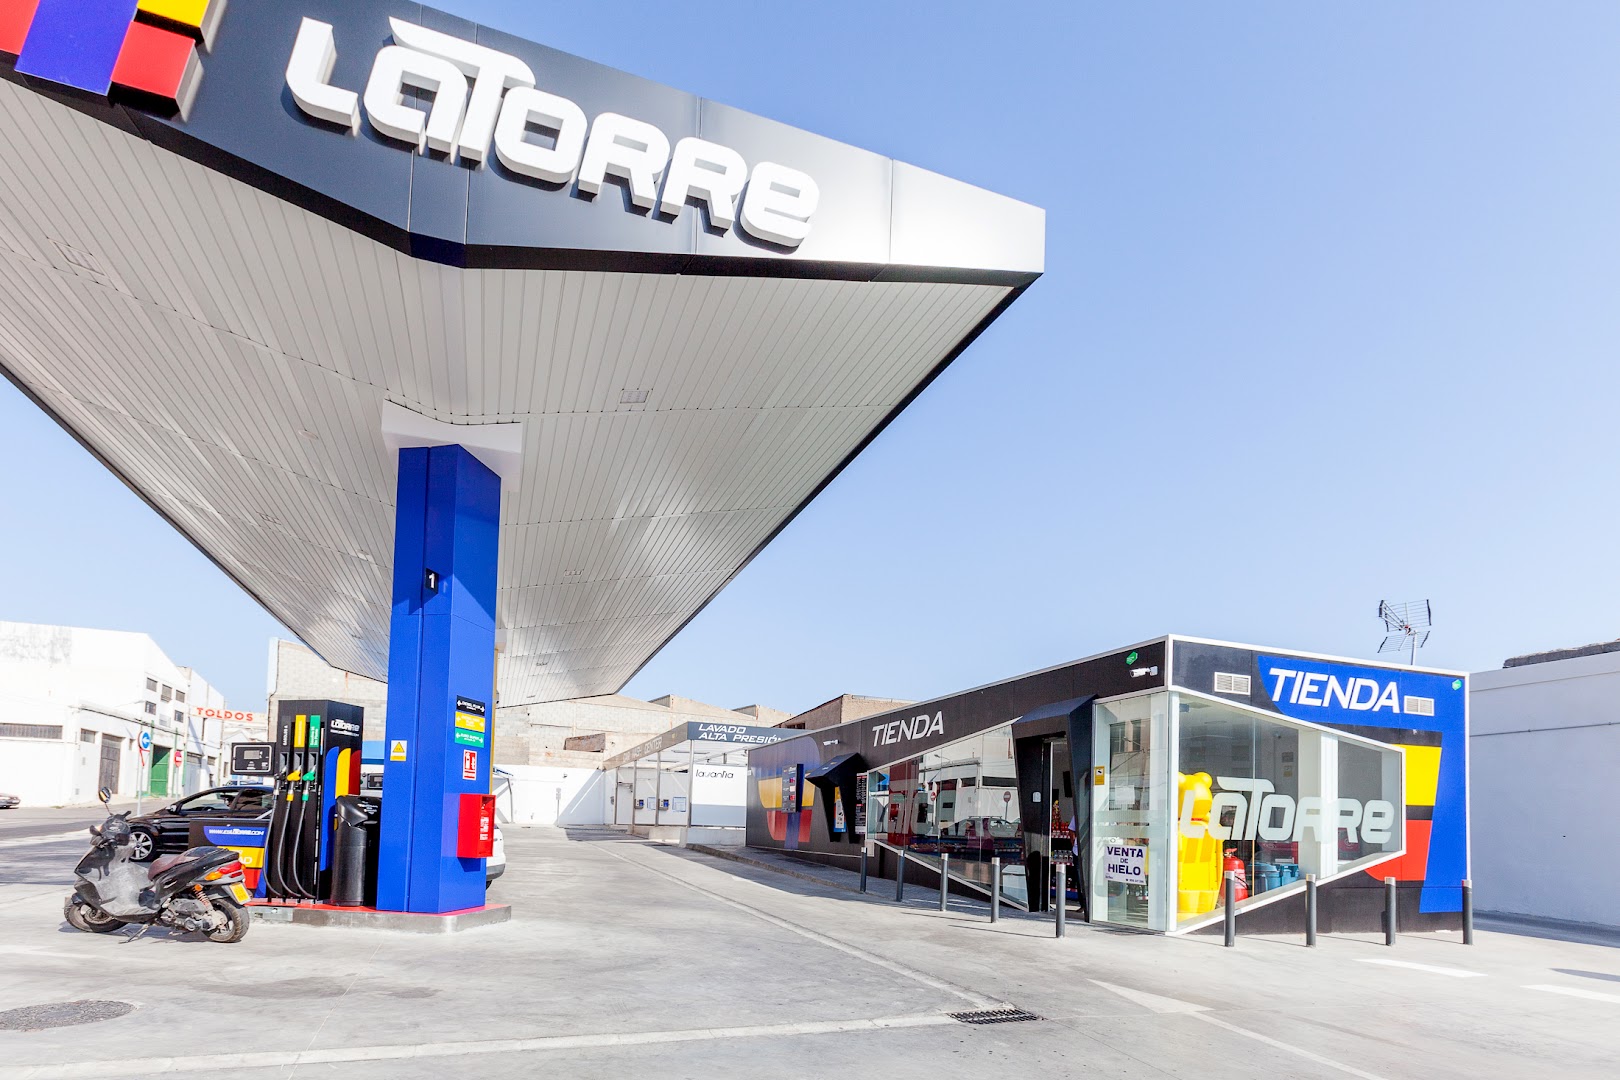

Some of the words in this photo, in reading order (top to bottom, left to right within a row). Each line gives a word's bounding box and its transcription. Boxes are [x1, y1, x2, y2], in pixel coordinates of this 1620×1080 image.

[428, 573, 436, 589] 1
[1269, 667, 1400, 713] TIENDA
[196, 707, 253, 721] TOLDOS
[698, 723, 747, 735] LAVADO
[872, 711, 944, 747] TIENDA
[698, 733, 727, 742] ALTA
[1107, 846, 1143, 858] VENTA
[1108, 863, 1140, 875] HIELO
